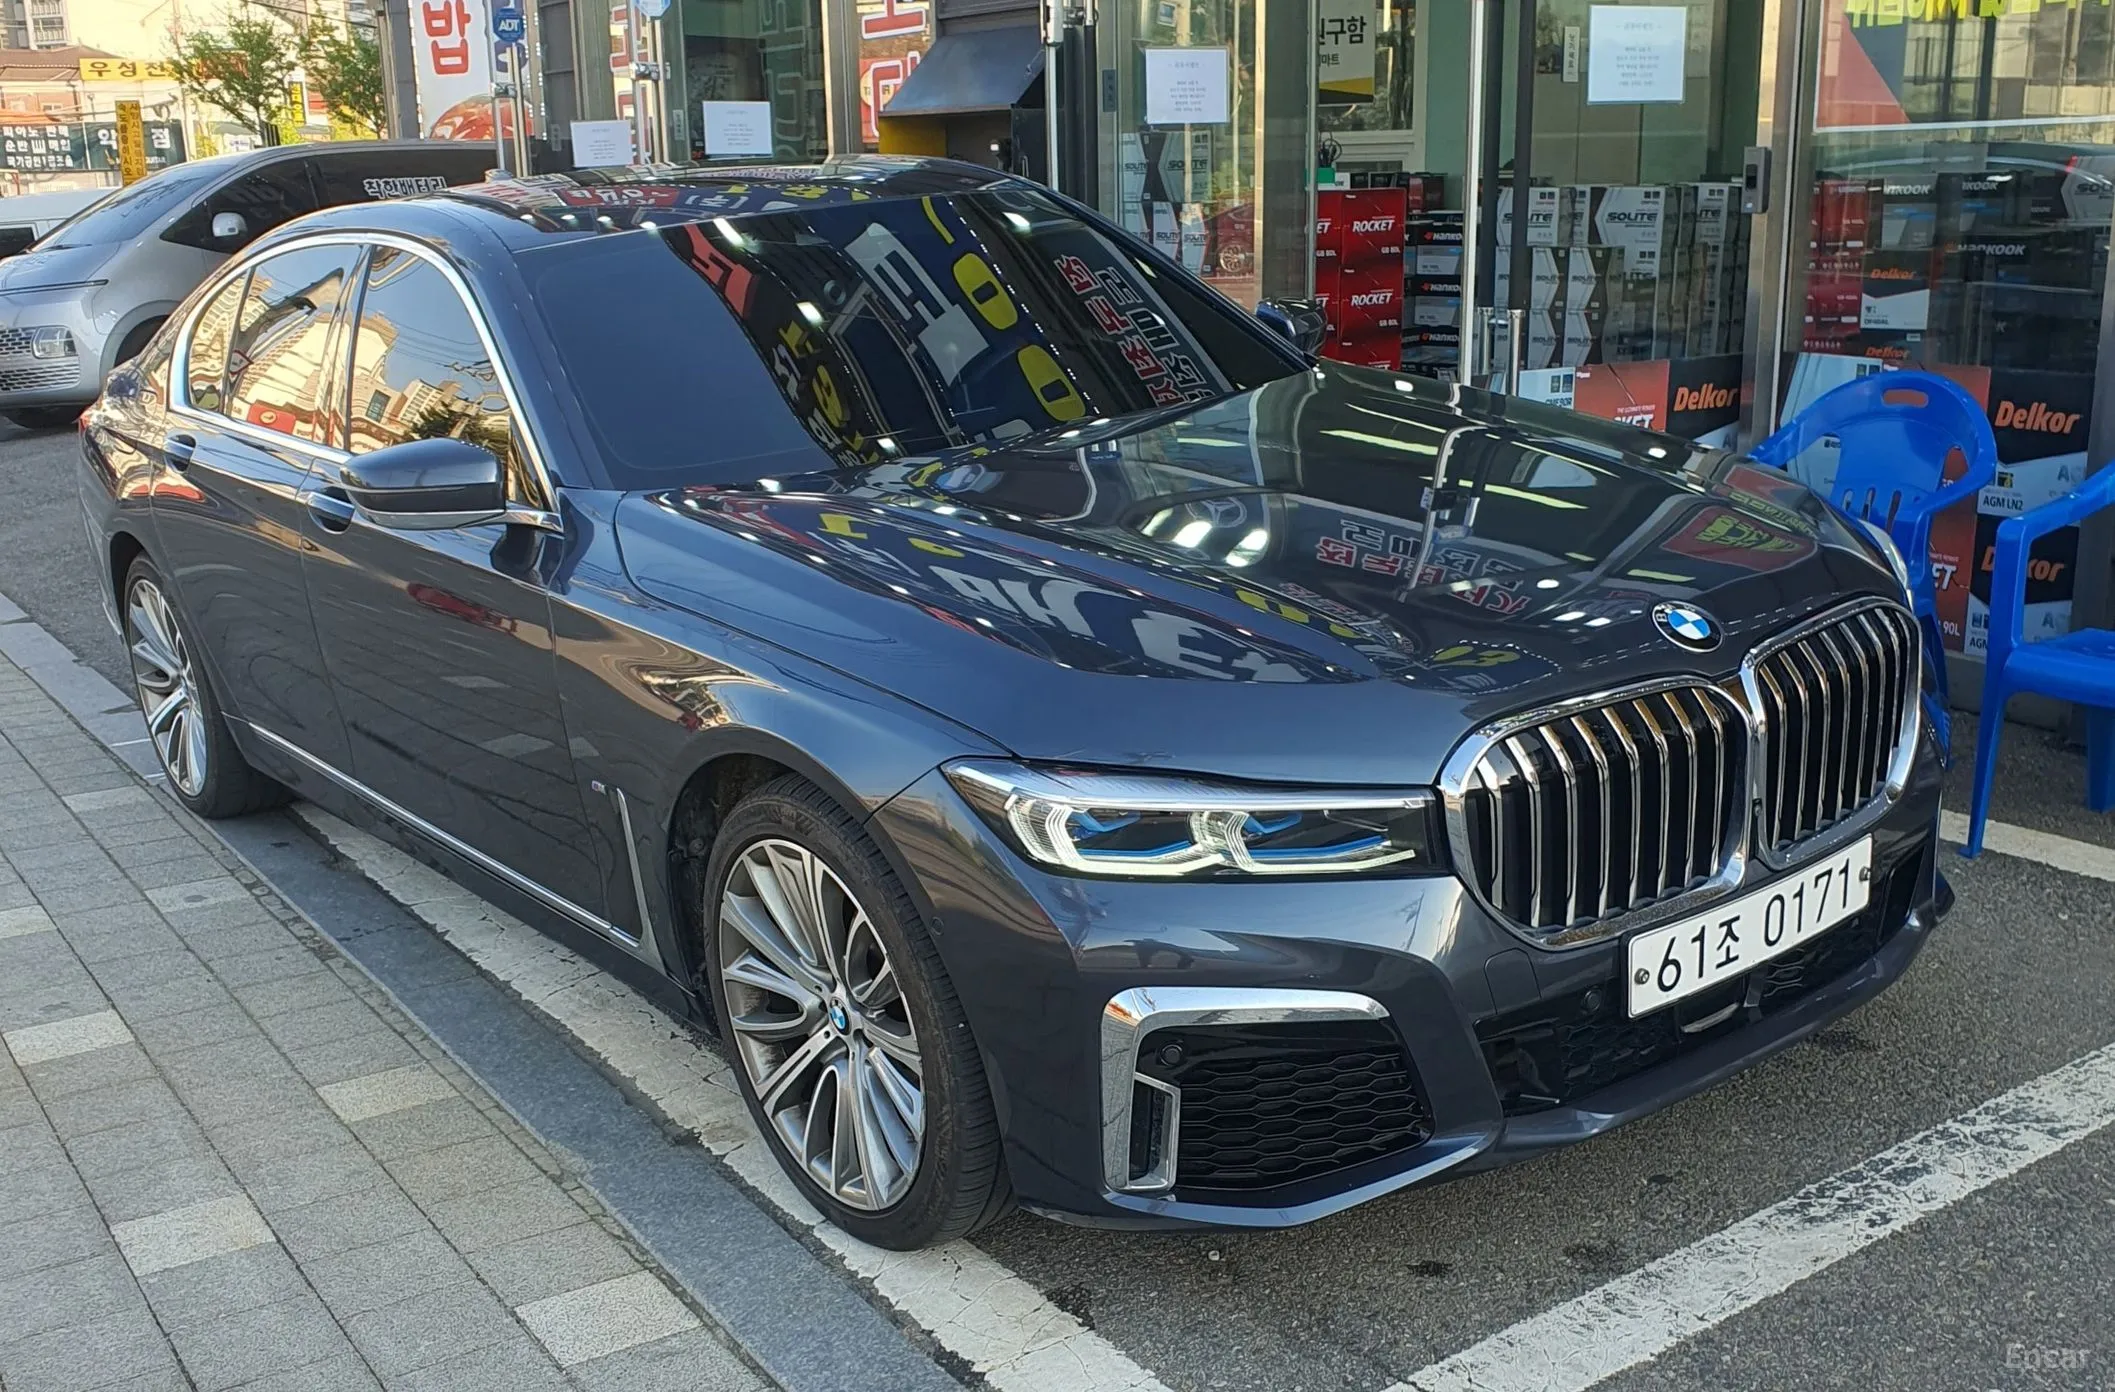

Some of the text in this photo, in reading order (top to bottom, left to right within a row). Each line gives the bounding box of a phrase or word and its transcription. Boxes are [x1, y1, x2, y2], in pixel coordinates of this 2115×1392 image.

[498, 19, 520, 31] ADT
[422, 0, 471, 75] 밥
[2, 126, 39, 138] 피아노
[97, 128, 171, 150] 악점
[363, 176, 448, 199] 착한배터리
[1607, 212, 1658, 221] SOLITE
[1352, 219, 1396, 233] ROCKET
[1351, 293, 1393, 306] ROCKET
[1674, 383, 1737, 412] Delkor
[1994, 400, 2081, 434] Delkor
[1983, 495, 2024, 511] AGM LN2
[1943, 620, 1960, 636] 90L
[1657, 857, 1851, 993] 61조 0171
